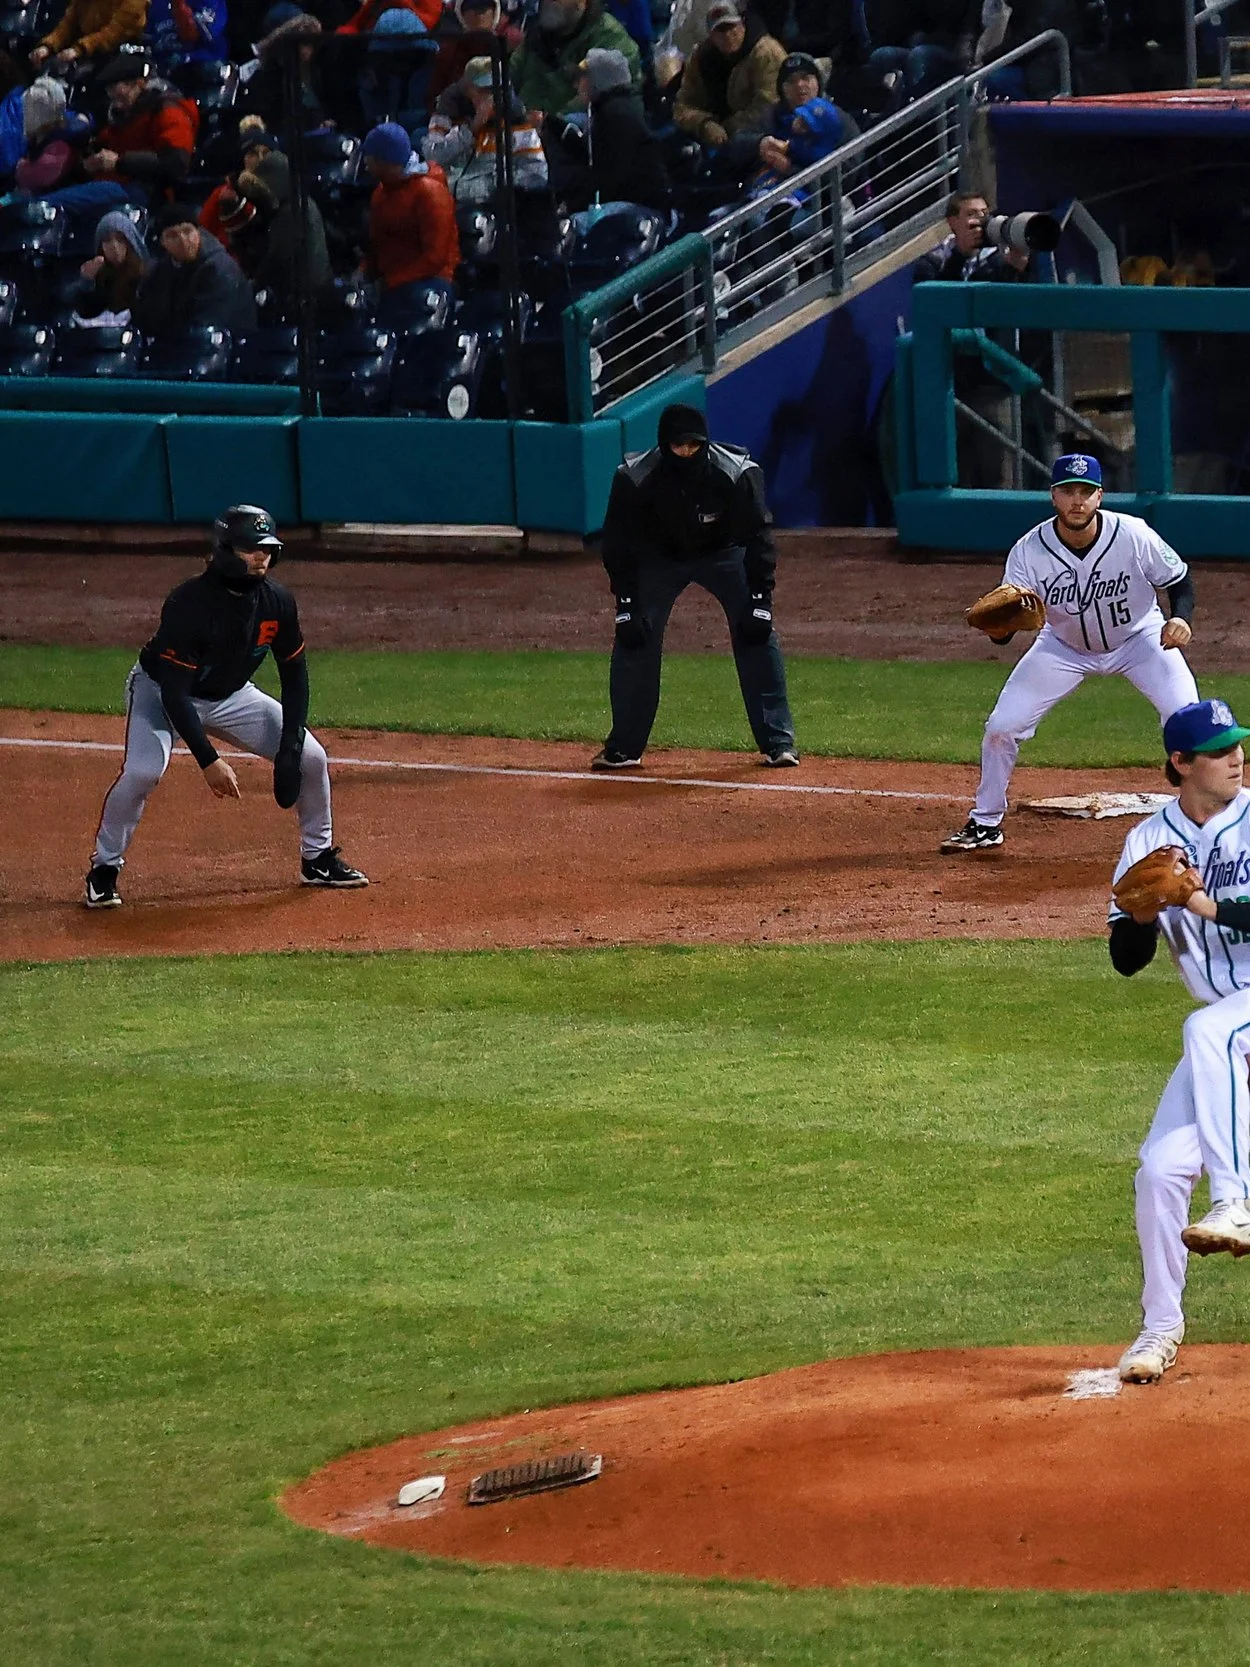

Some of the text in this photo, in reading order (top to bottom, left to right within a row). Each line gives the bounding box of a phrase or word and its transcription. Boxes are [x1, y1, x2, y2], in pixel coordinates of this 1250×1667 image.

[1040, 569, 1130, 614] Yard Goats
[1107, 597, 1132, 628] 15
